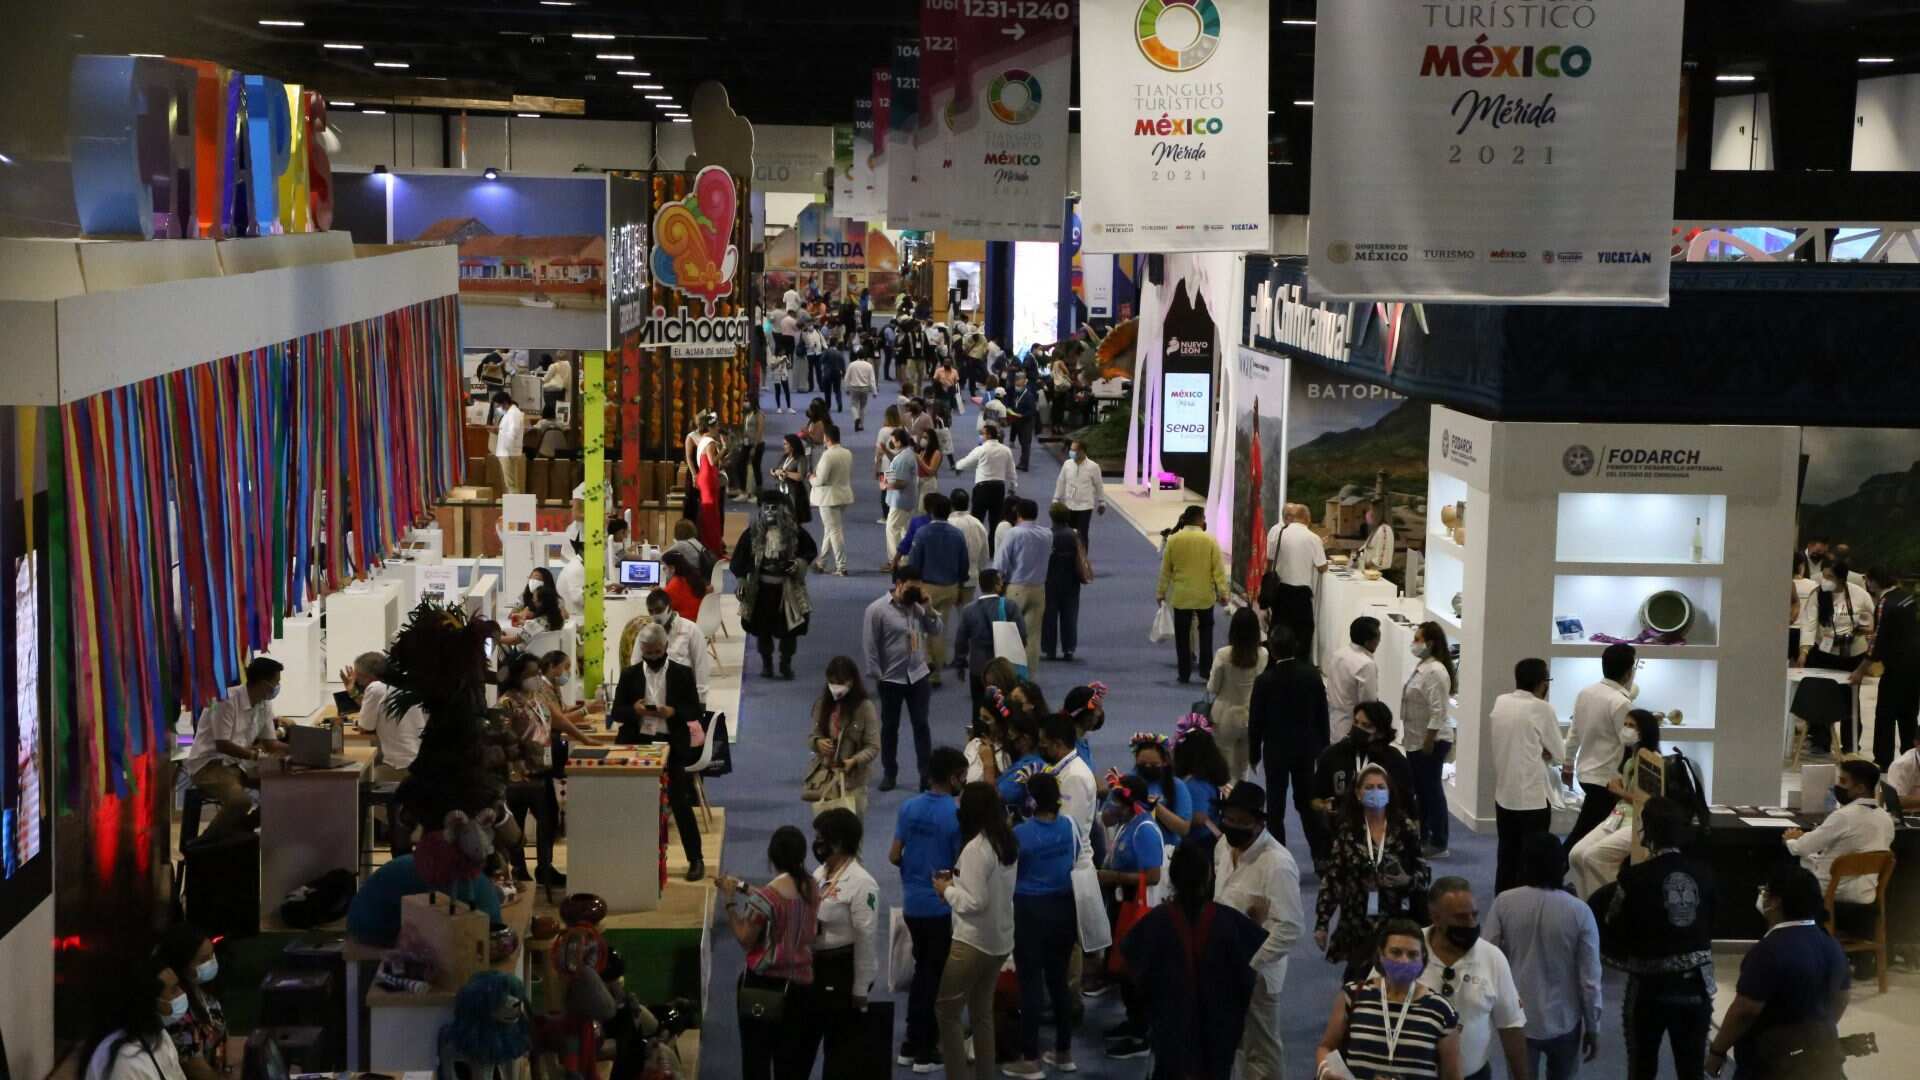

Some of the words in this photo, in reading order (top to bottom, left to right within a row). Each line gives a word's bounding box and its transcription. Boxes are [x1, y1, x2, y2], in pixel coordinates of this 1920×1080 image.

[1421, 1, 1597, 29] TURÍSTICO
[1134, 83, 1224, 97] TIANGUIS
[1134, 95, 1224, 111] TURÍSTICO
[1450, 89, 1557, 135] Mérida
[1151, 141, 1207, 166] Mérida
[800, 238, 865, 257] MÉRIDA
[1354, 249, 1409, 262] MÉXICO
[1423, 249, 1475, 259] TURISMO
[1597, 250, 1652, 264] YUCATÁN
[1180, 340, 1209, 348] NUEVO
[1608, 449, 1701, 465] FODARCH
